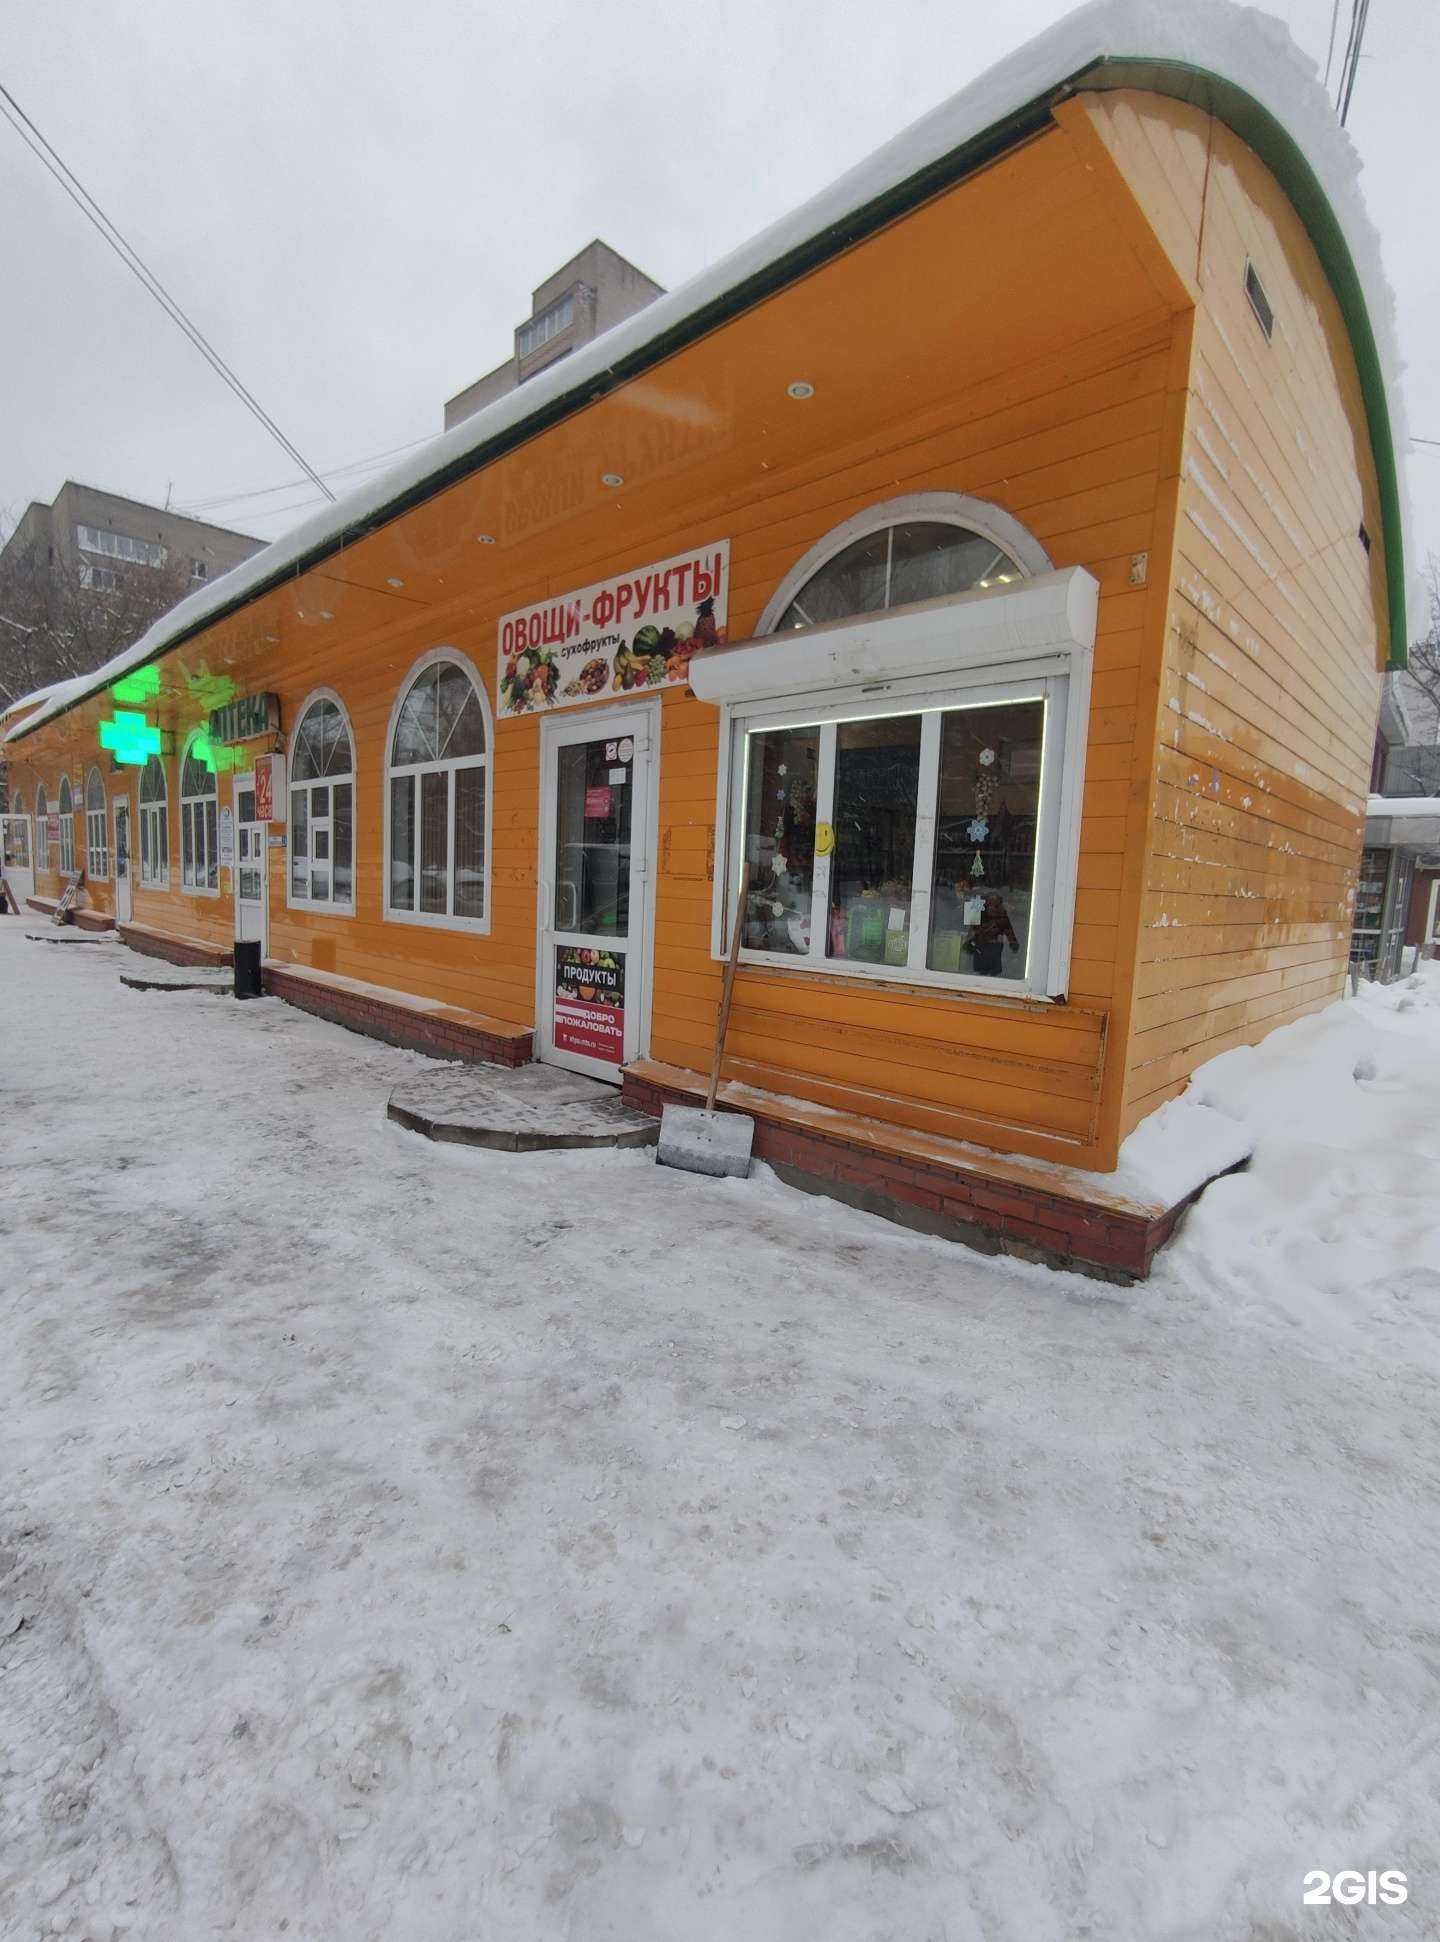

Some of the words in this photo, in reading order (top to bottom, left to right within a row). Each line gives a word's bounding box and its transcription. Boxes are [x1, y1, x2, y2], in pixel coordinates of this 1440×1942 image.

[502, 553, 722, 656] ОВОЩИ-ФРУКТЫ
[561, 633, 620, 660] сухофрукты
[564, 965, 617, 987] ПРОДУКТЫ
[560, 1015, 623, 1037] ПОЖАЛОВАТЬ
[584, 1010, 616, 1024] ДОБРО
